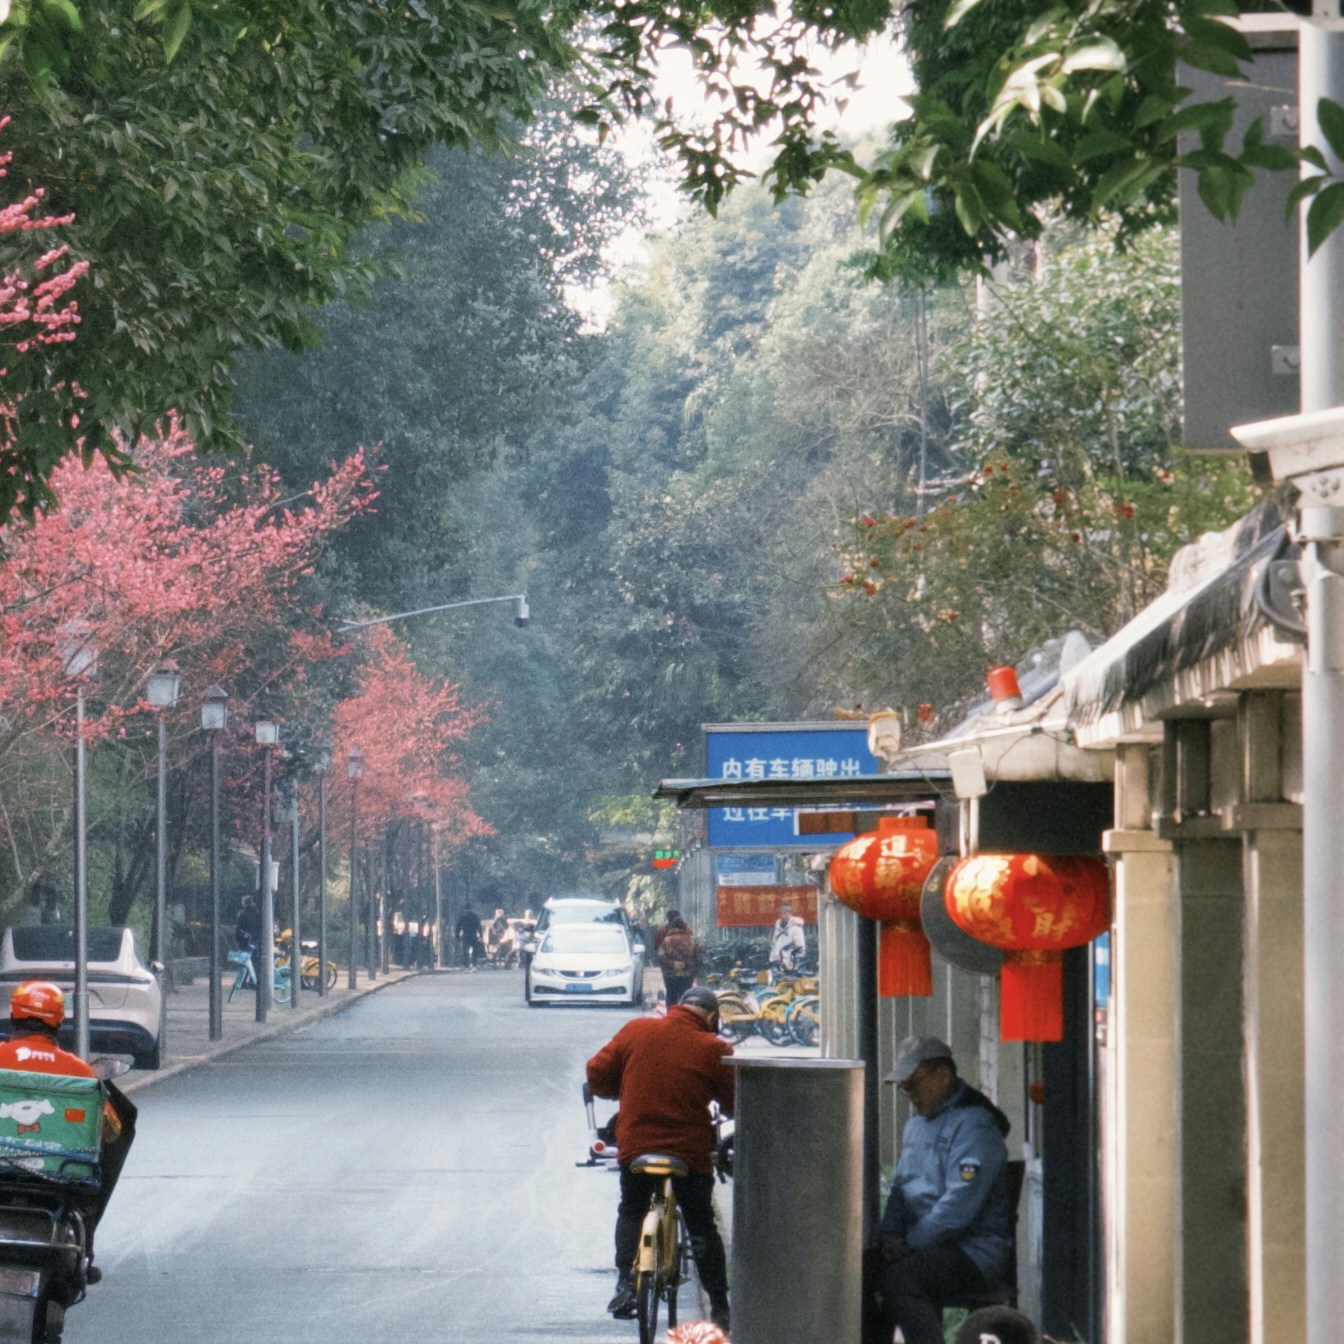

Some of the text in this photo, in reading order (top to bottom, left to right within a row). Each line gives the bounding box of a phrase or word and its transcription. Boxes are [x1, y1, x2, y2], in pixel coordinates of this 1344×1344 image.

[722, 758, 861, 778] 内有车辆驶出
